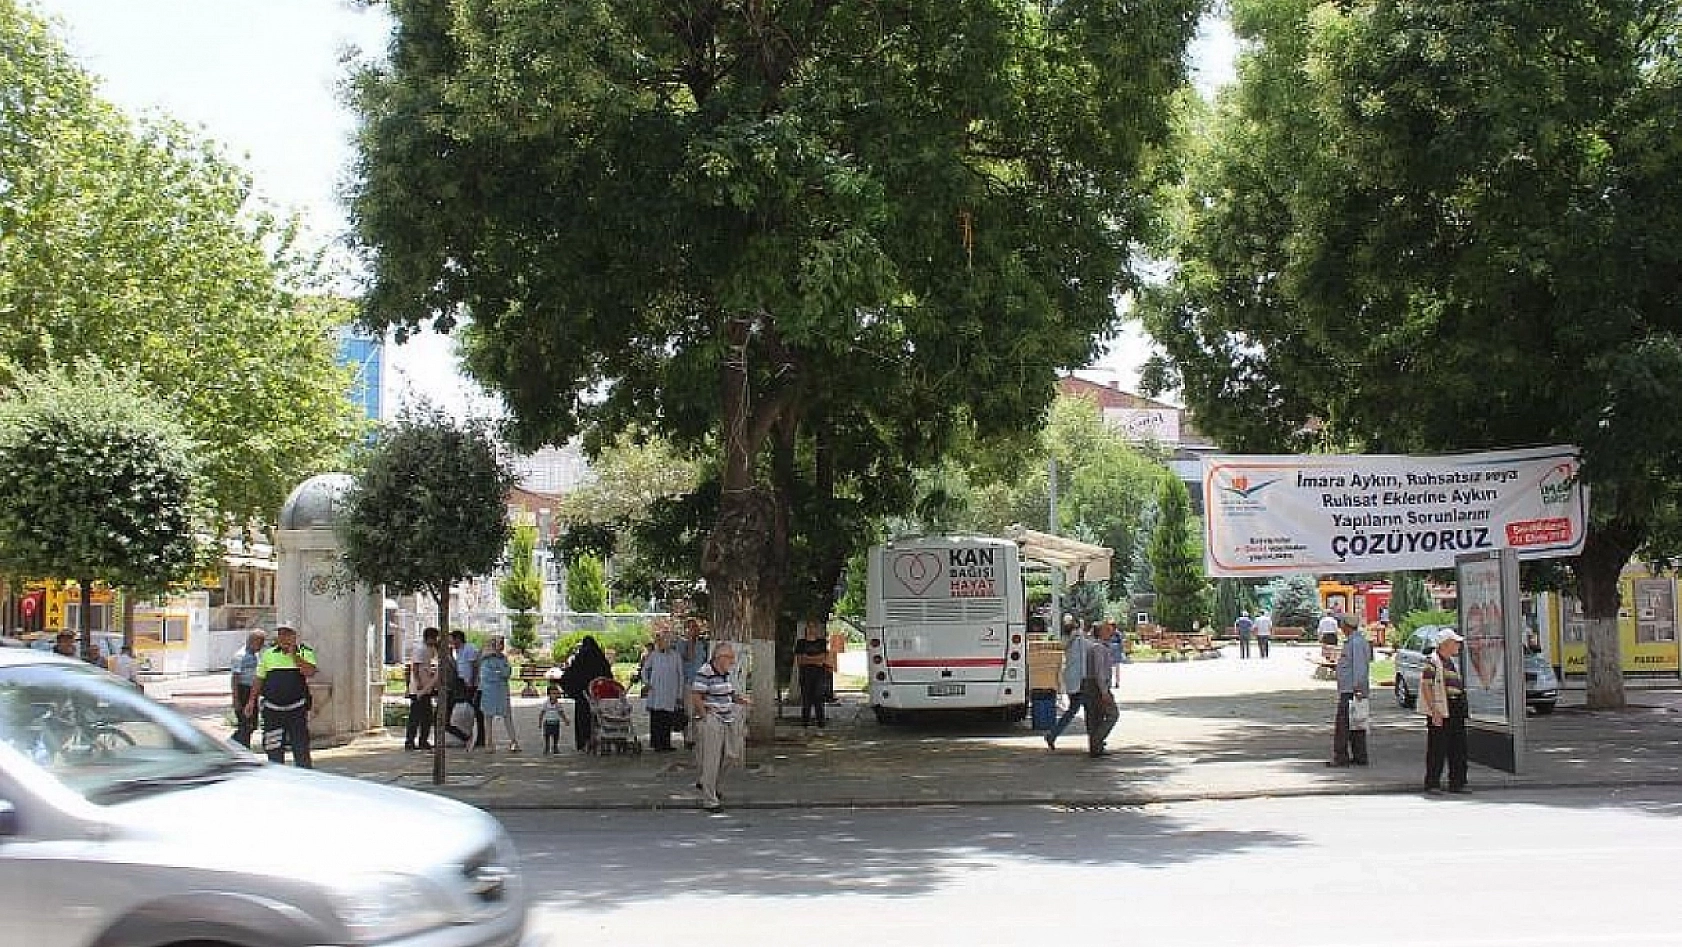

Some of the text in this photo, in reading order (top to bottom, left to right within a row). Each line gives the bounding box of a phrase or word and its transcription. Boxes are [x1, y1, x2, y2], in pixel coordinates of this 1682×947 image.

[1321, 493, 1378, 508] Ruhsat
[1383, 490, 1447, 505] Eklerine
[1331, 527, 1493, 562] ÇÖZÜYORUZ
[949, 548, 994, 566] KAN
[949, 566, 994, 580] BAĞIŞI
